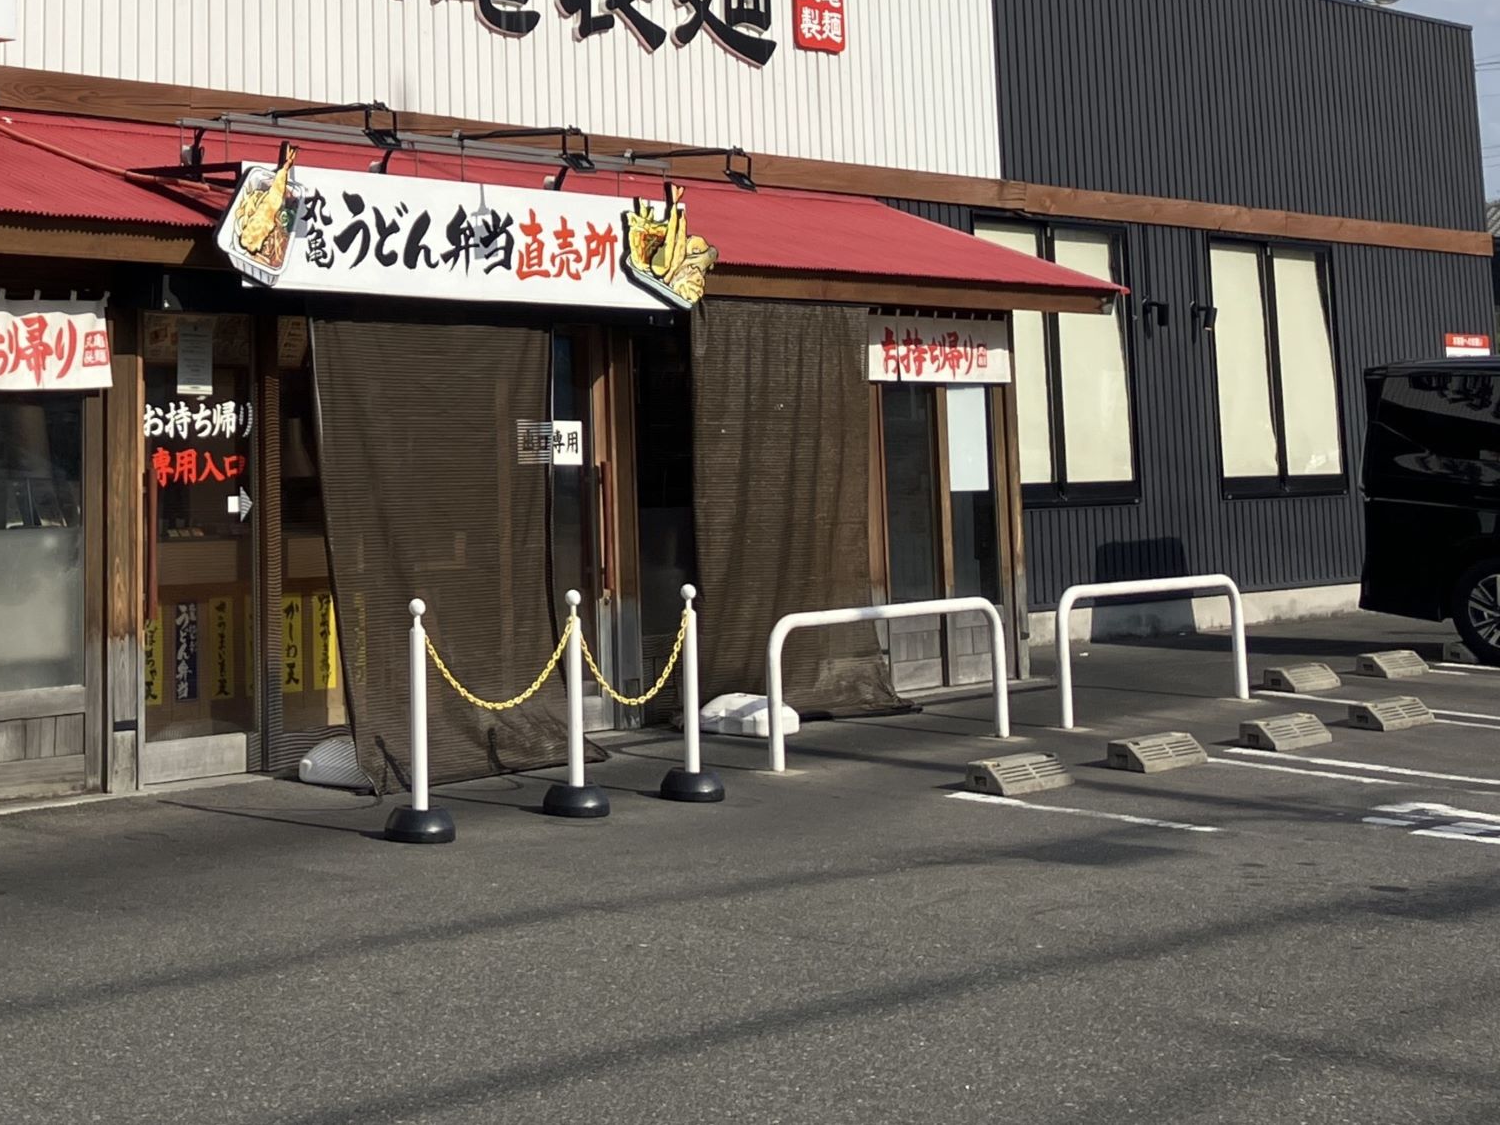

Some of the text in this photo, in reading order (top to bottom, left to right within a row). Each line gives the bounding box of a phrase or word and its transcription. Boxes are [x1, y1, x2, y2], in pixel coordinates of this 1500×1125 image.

[800, 6, 843, 43] 製麺
[143, 400, 254, 440] お持ち帰り
[152, 447, 246, 487] 専用入口
[283, 600, 300, 686] かしわ天
